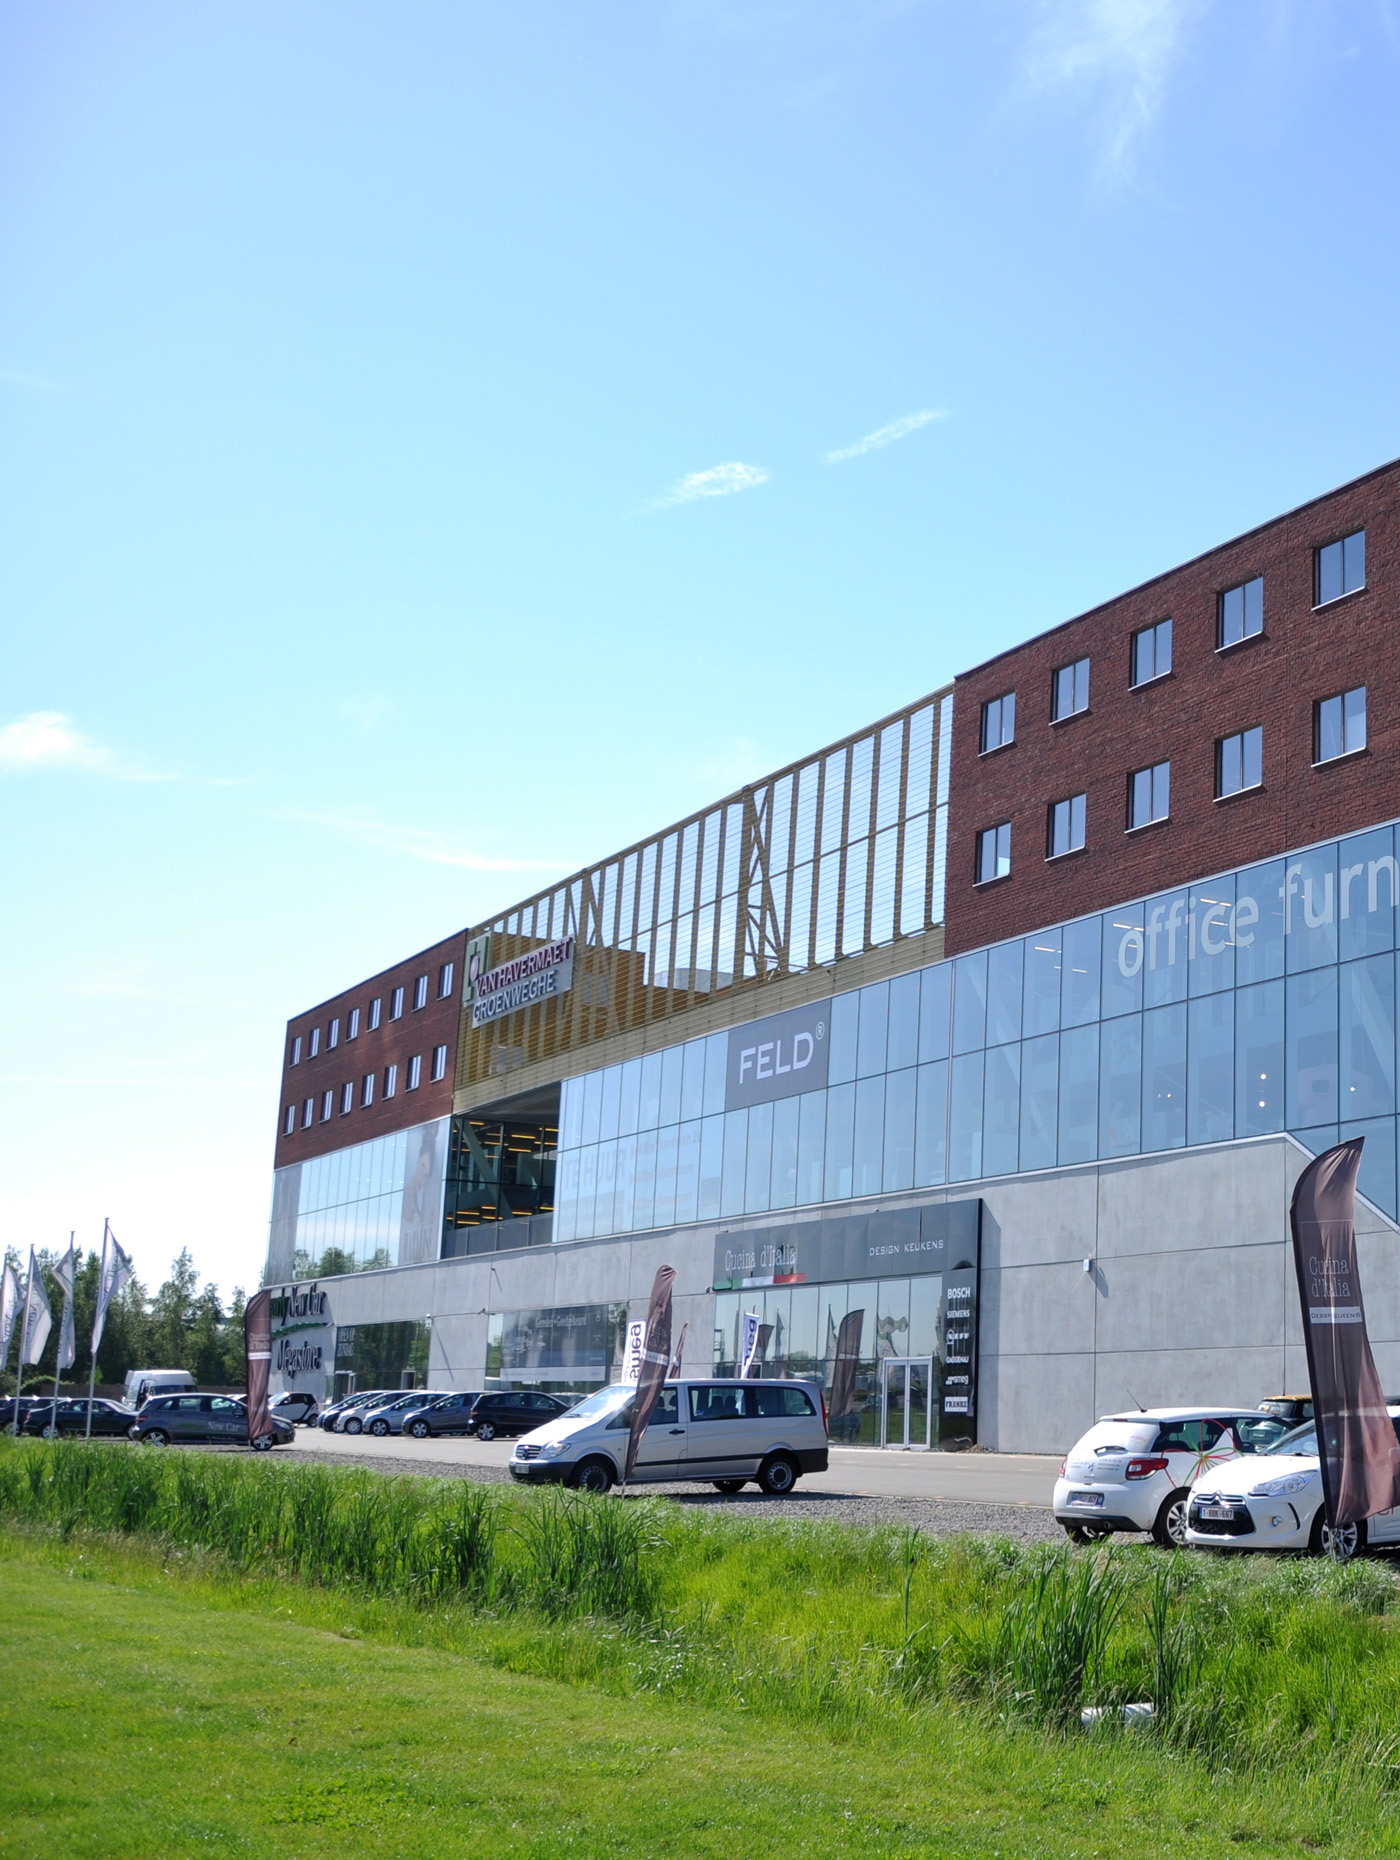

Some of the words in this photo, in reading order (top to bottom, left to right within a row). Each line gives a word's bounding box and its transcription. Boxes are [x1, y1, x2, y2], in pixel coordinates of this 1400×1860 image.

[1118, 895, 1260, 979] office
[475, 971, 498, 998] VAN
[498, 937, 573, 988] HAVERMAET
[472, 969, 557, 1021] GROENWEGHE
[725, 1249, 756, 1271] Cucina
[869, 1245, 900, 1256] DESIGN
[903, 1239, 944, 1253] KEUKENS
[947, 1287, 971, 1299] BOSCH
[947, 1309, 970, 1319] SIEMENS
[277, 1340, 322, 1379] Megastore
